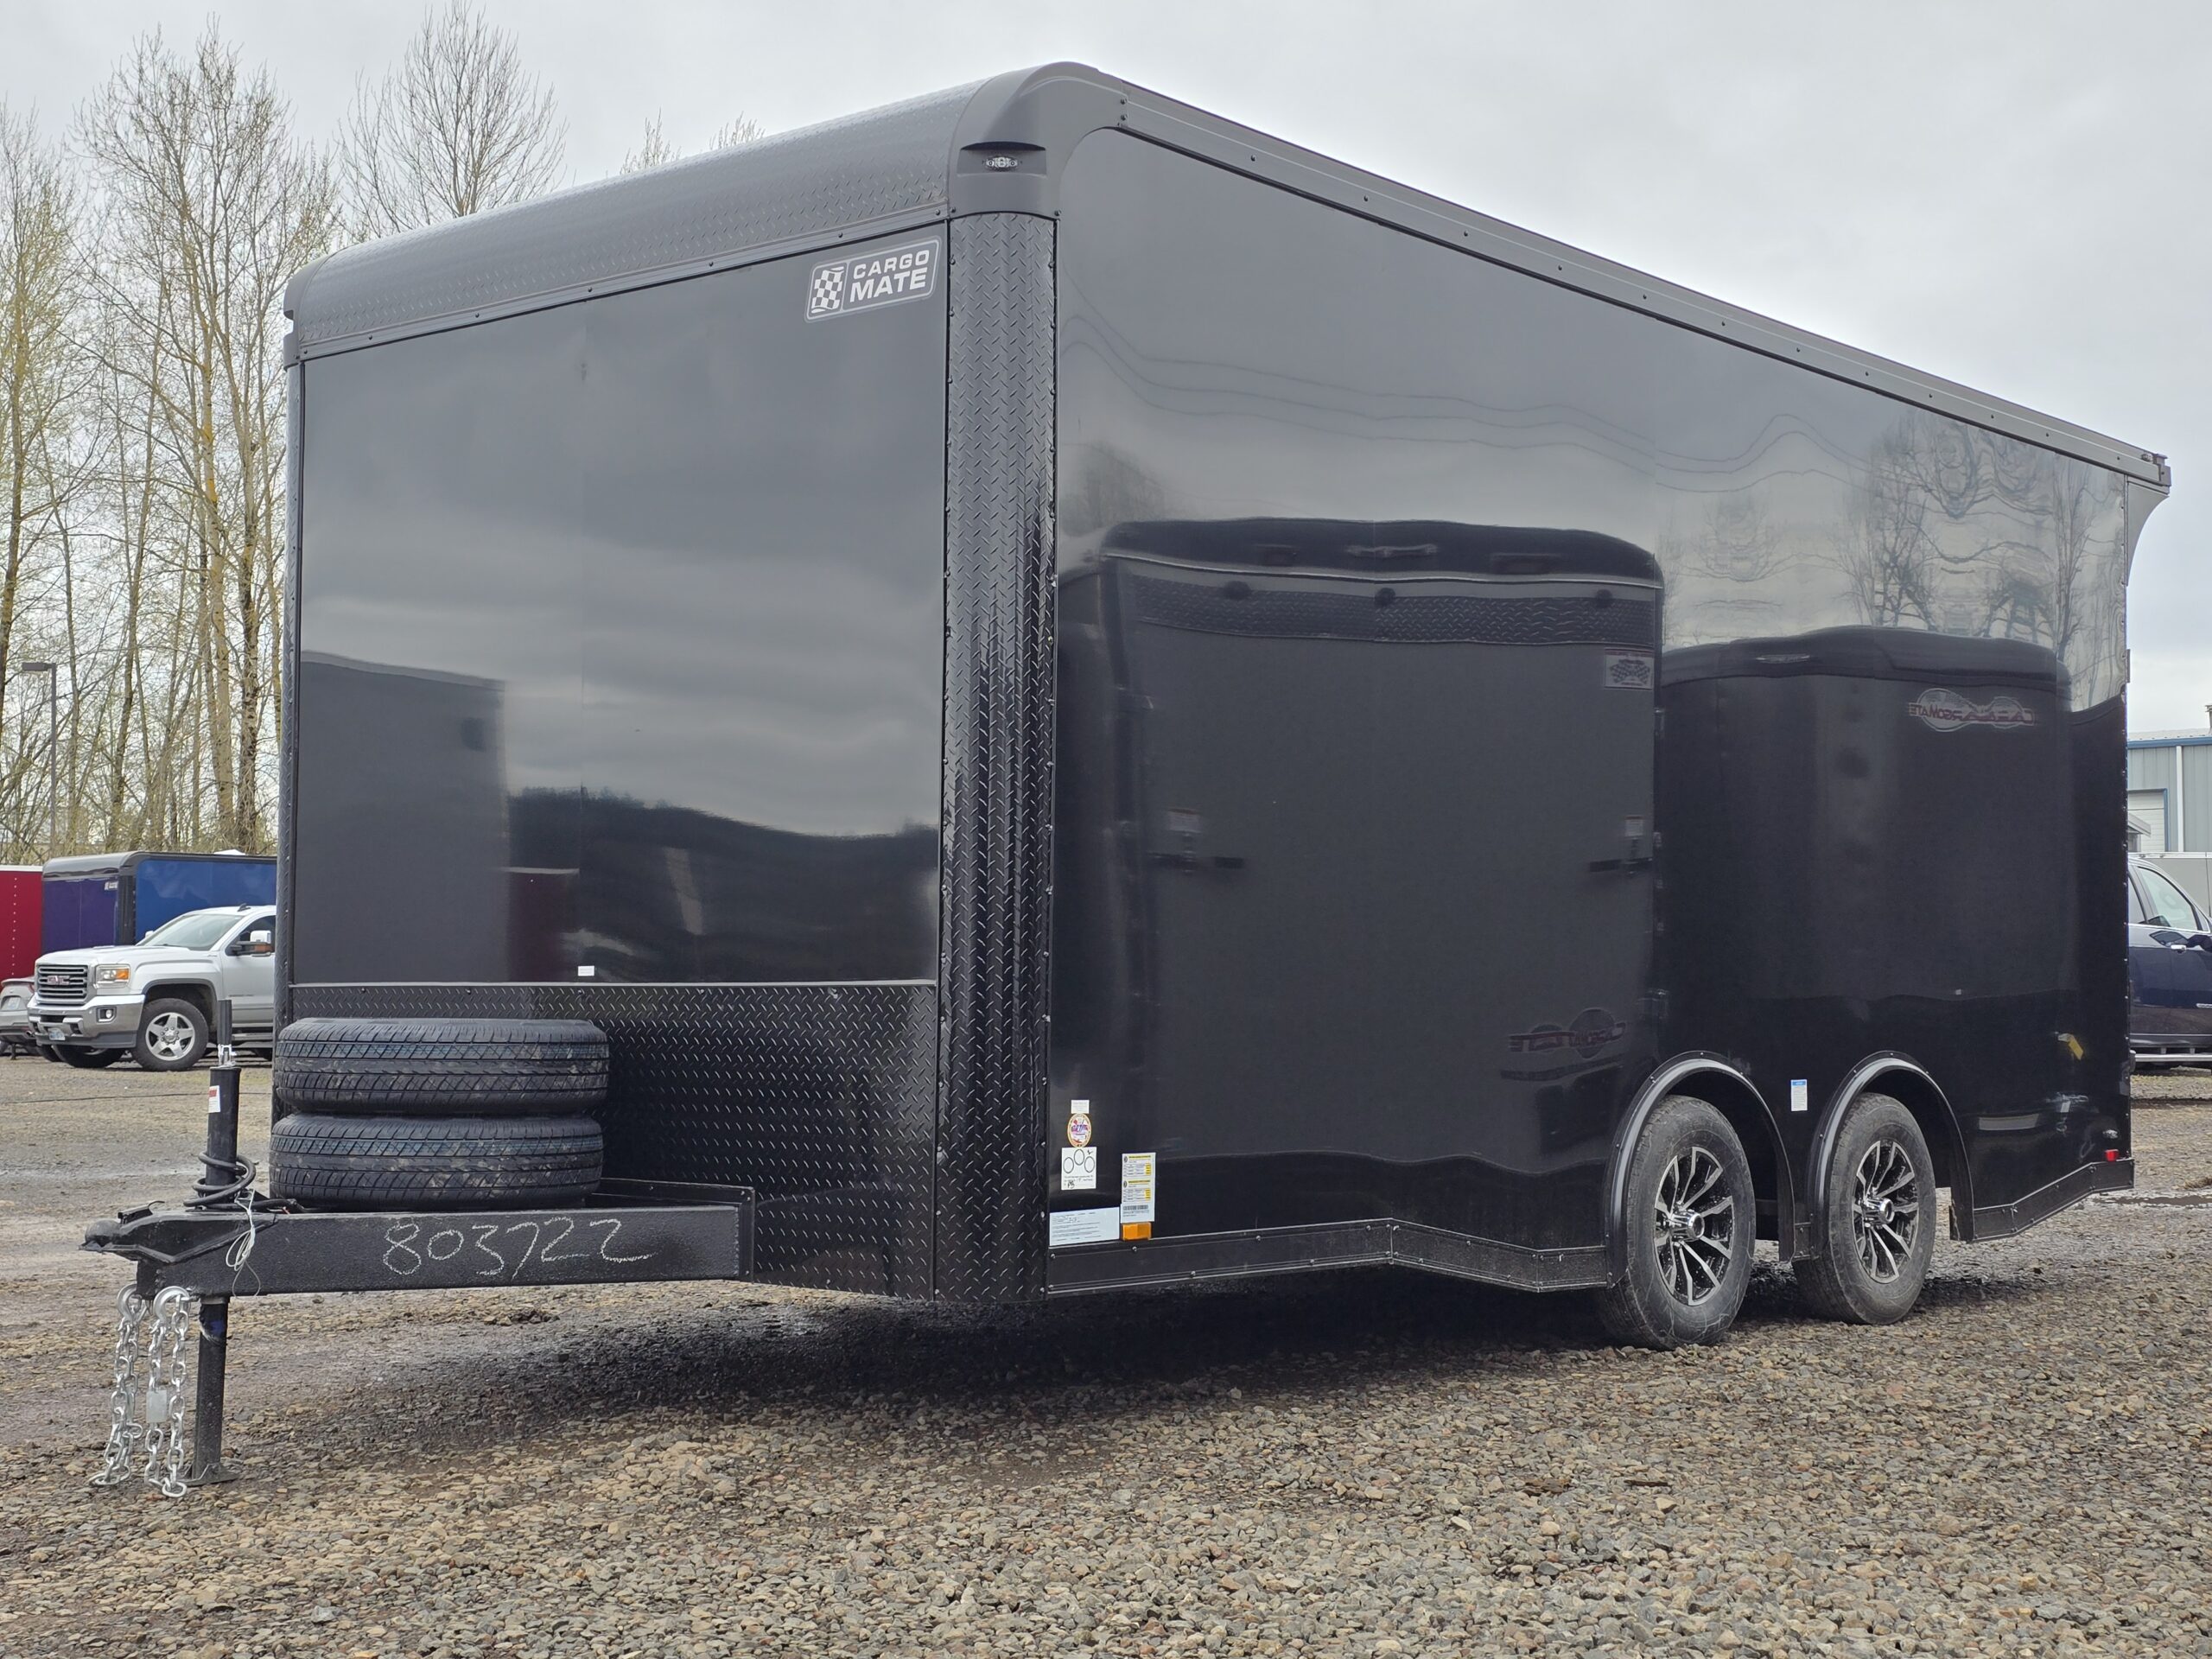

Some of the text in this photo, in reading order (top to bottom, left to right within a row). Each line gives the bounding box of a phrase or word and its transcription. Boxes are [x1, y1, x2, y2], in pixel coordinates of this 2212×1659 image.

[853, 250, 930, 279] CARGO
[849, 267, 928, 302] MATE
[383, 1217, 658, 1281] 803722
